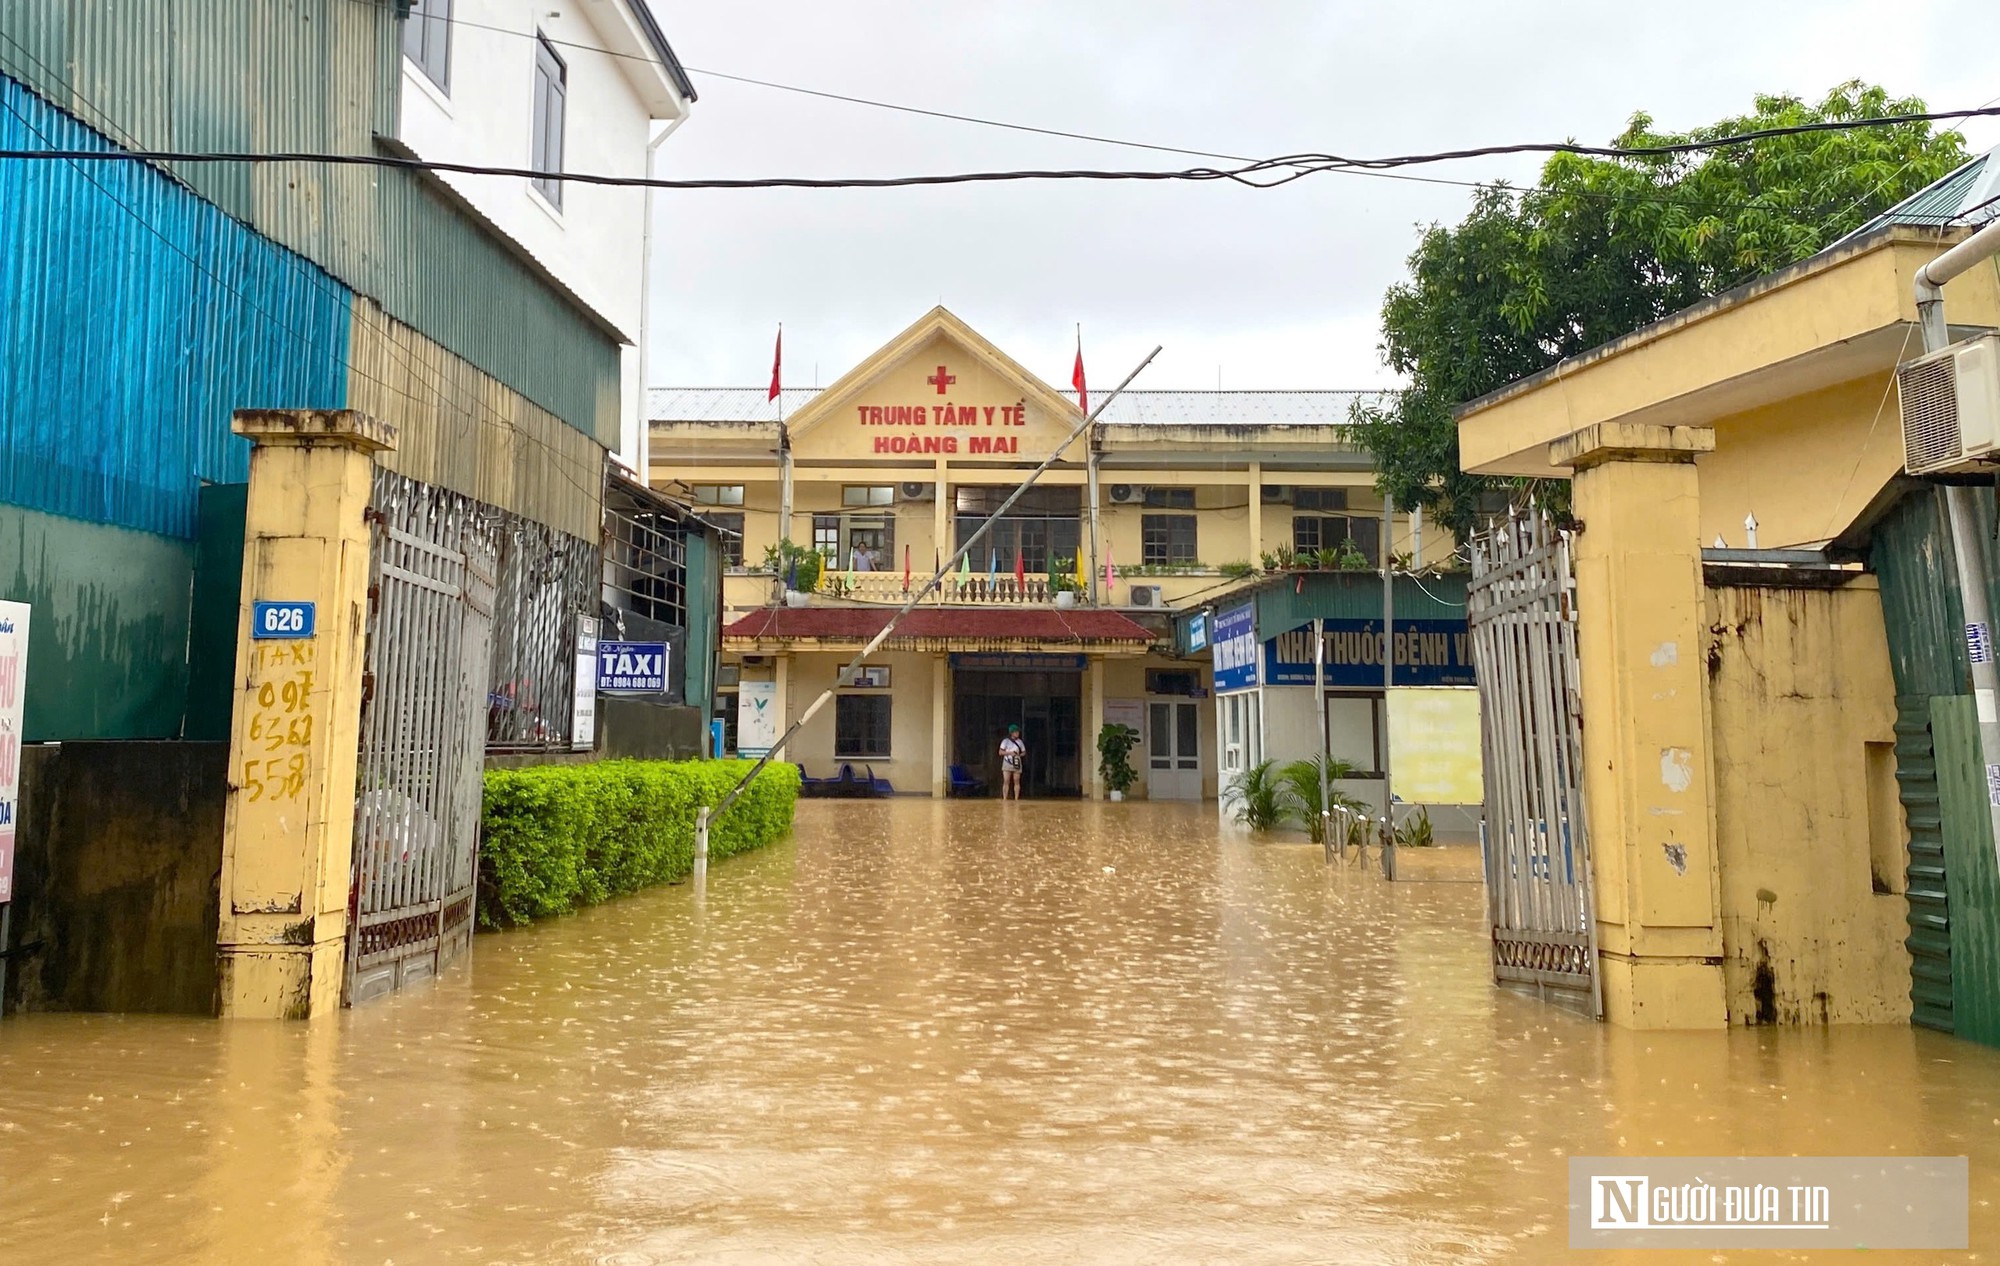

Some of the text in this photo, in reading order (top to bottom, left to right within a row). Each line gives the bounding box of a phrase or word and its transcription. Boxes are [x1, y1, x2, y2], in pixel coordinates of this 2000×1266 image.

[858, 397, 1026, 426] TRUNG TÂM Y TẾ
[874, 432, 1017, 454] HOÀNG MAI
[265, 607, 303, 631] 626
[1276, 624, 1316, 664] NHÀ
[1323, 620, 1385, 665] THUỐC
[1394, 625, 1449, 673] BỆNH
[602, 653, 662, 675] TAXI
